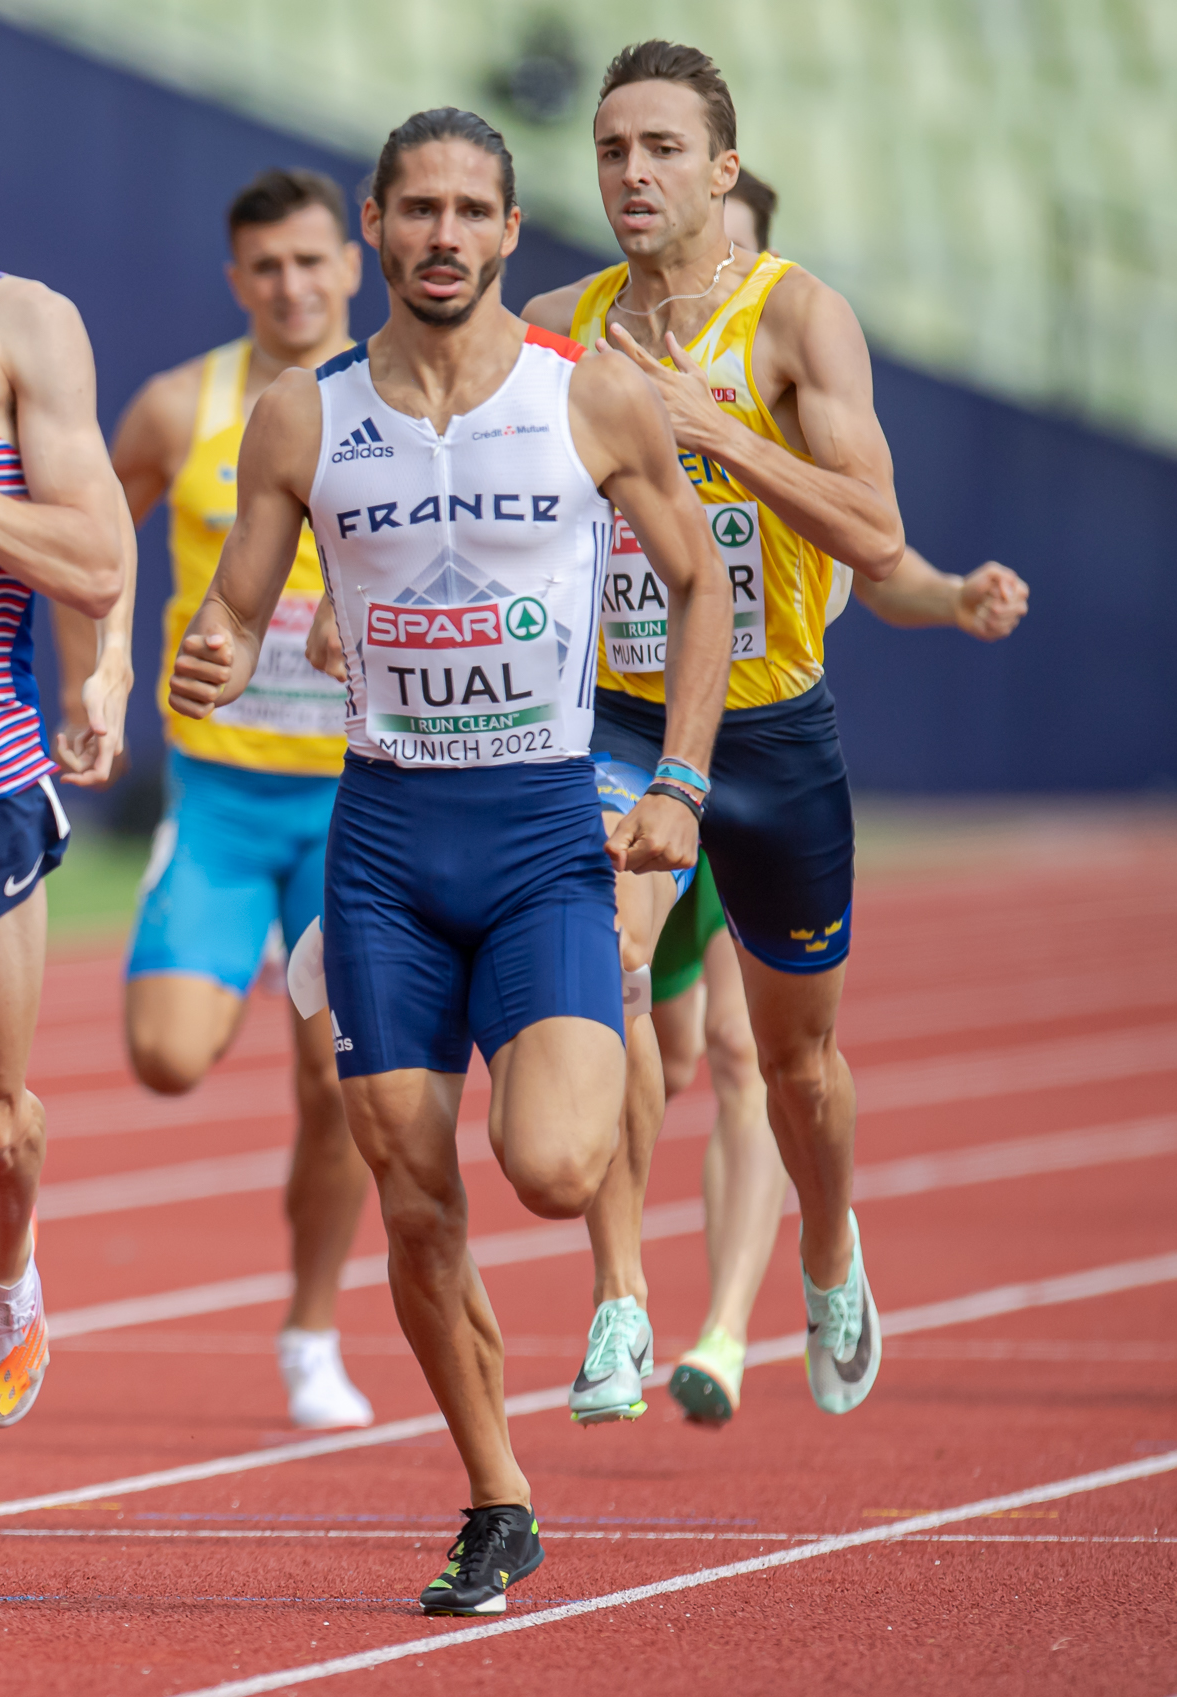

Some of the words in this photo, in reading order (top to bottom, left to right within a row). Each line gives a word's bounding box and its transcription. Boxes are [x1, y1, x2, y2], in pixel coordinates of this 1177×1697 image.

[331, 444, 395, 463] adidas
[336, 493, 560, 539] FRANCE
[602, 564, 758, 612] KRAR
[370, 611, 499, 643] SPAR
[628, 621, 662, 637] RUN
[612, 641, 666, 666] MUNIC
[387, 662, 533, 707] TUAL
[419, 717, 454, 733] RUN
[378, 737, 481, 762] MUNICH
[490, 728, 553, 758] 2022
